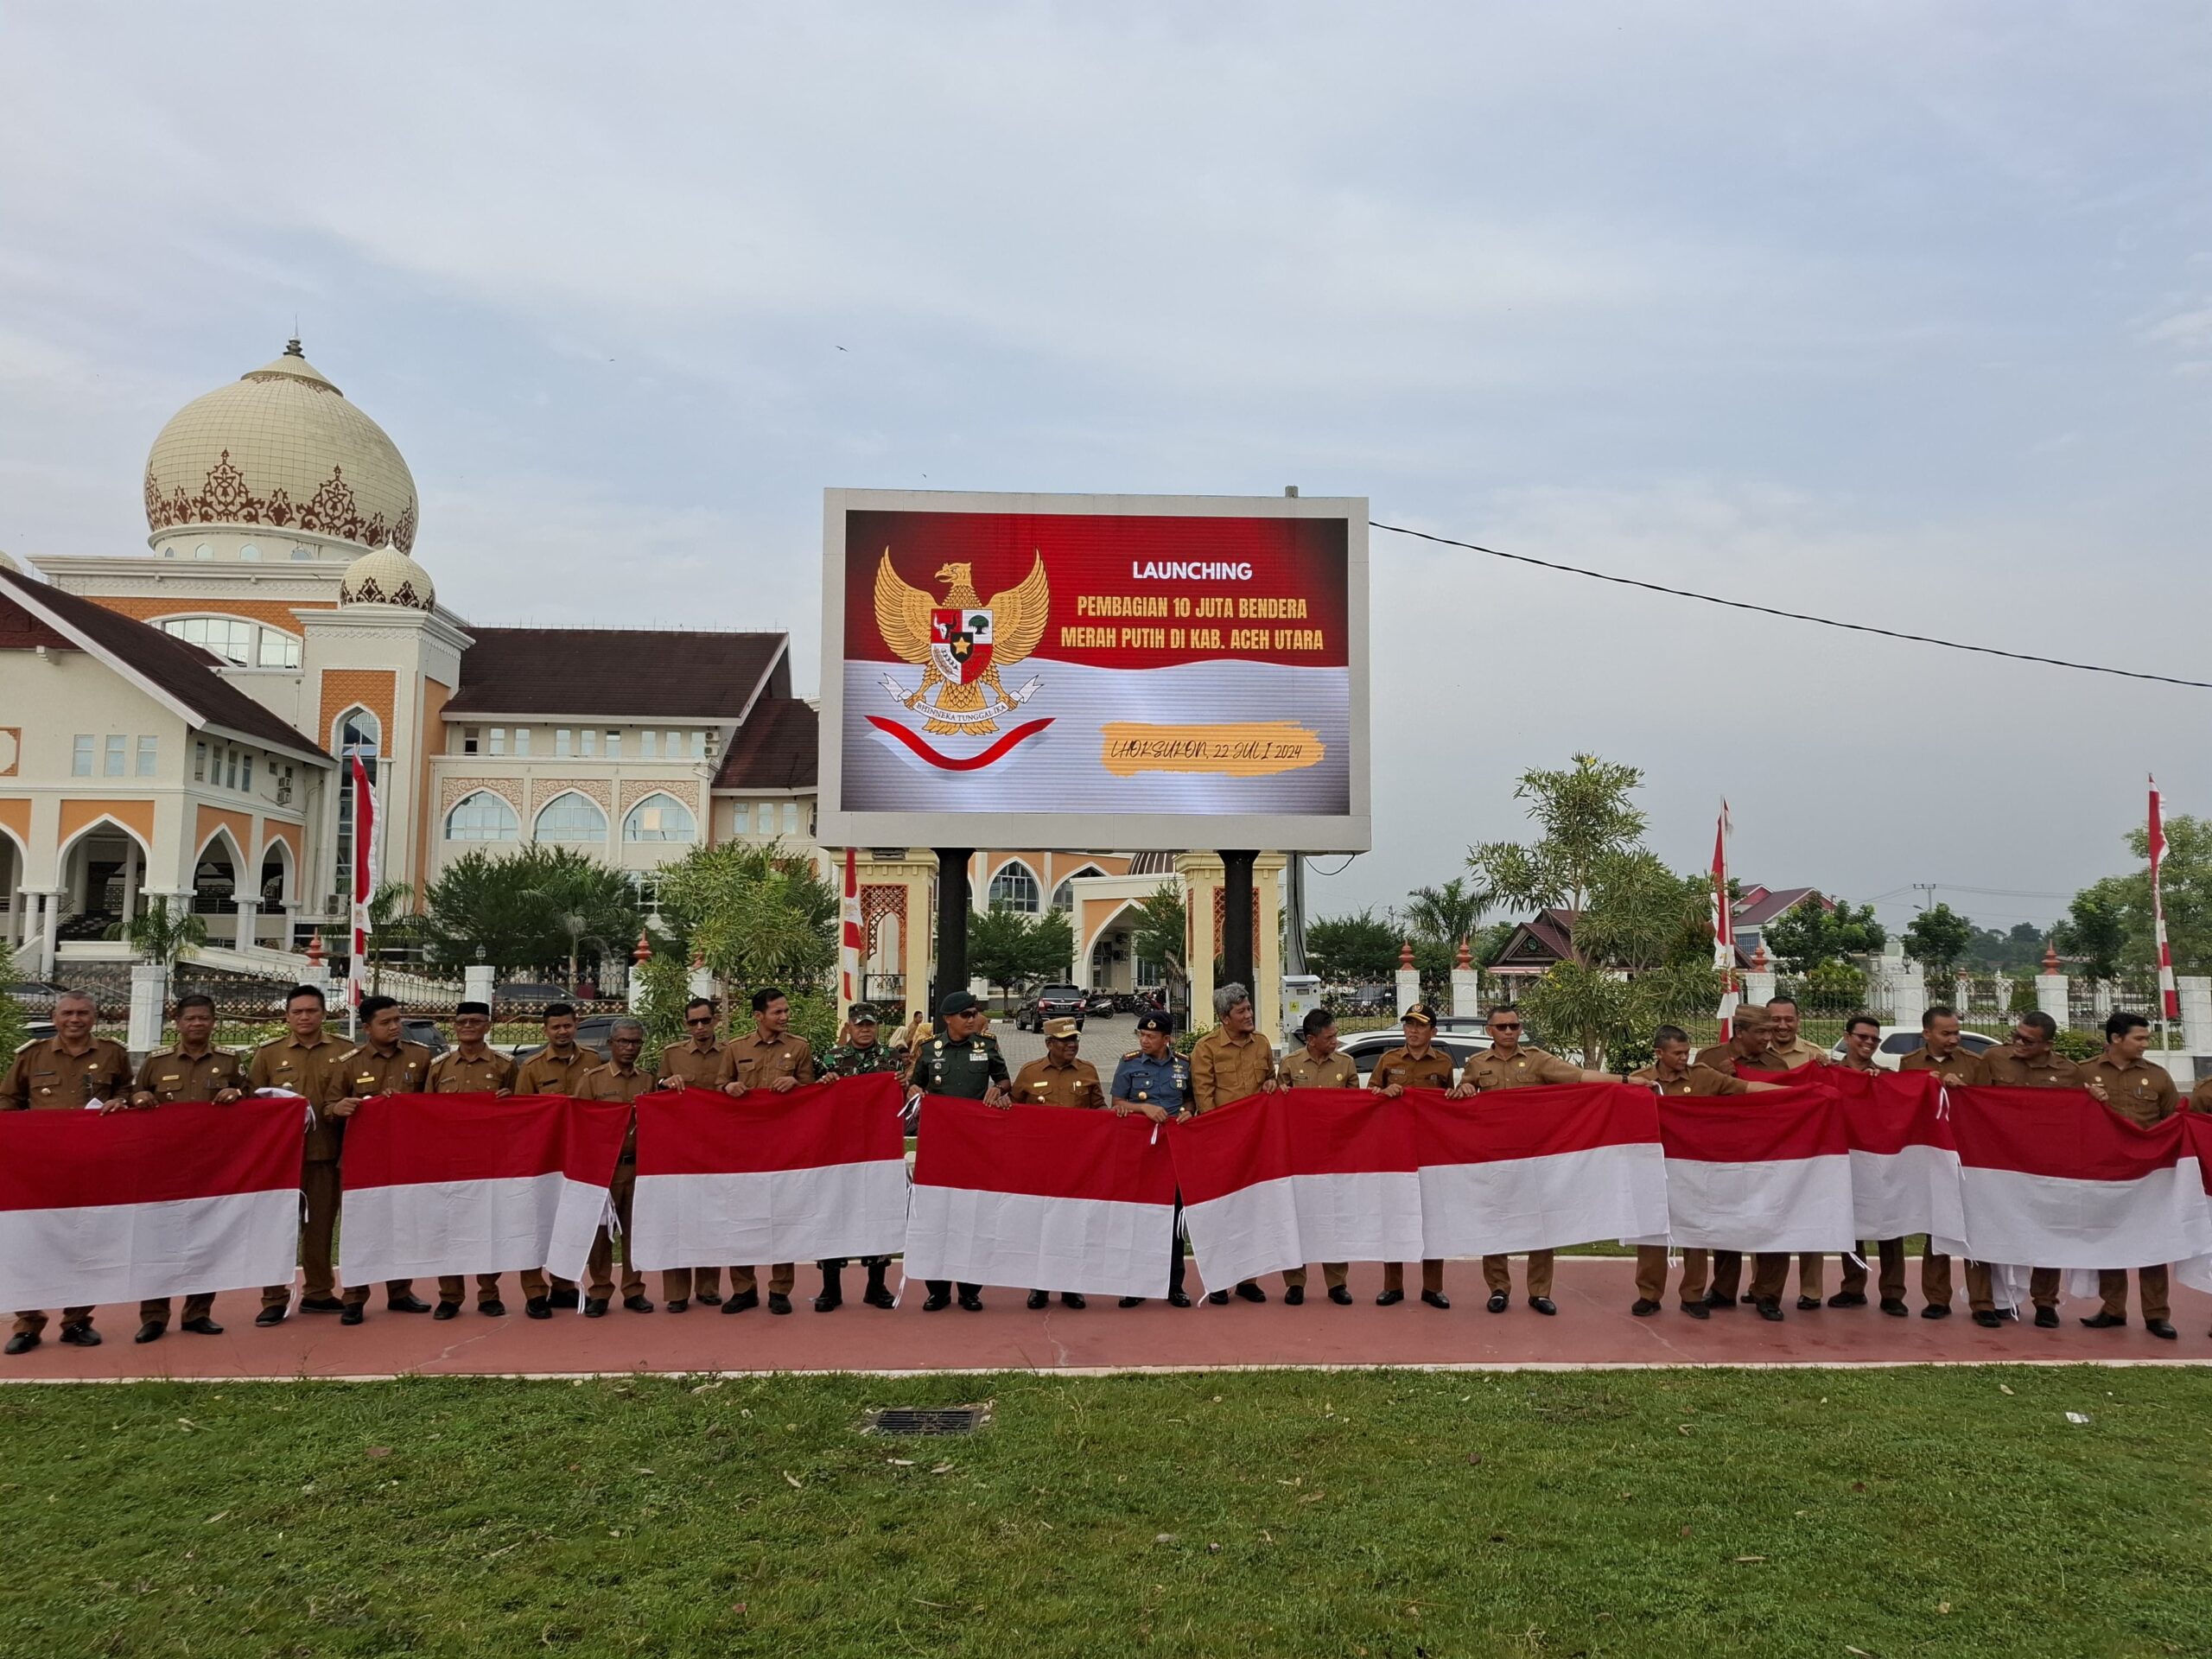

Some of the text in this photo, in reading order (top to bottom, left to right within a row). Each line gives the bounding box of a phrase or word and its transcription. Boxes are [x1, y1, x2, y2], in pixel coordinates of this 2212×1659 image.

[1133, 561, 1253, 580] LAUNCHING
[1077, 595, 1307, 620] PEMBAGIAN 10 JUTA BENDERA
[1061, 626, 1324, 651] MERAH PUTIH DI KAB. ACEH UTARA
[917, 702, 1007, 721] BHINNEKA TUNGGAL IKA
[1110, 740, 1209, 760] LHOKSUKON,
[1213, 744, 1230, 759] 22
[1274, 744, 1303, 760] 2024
